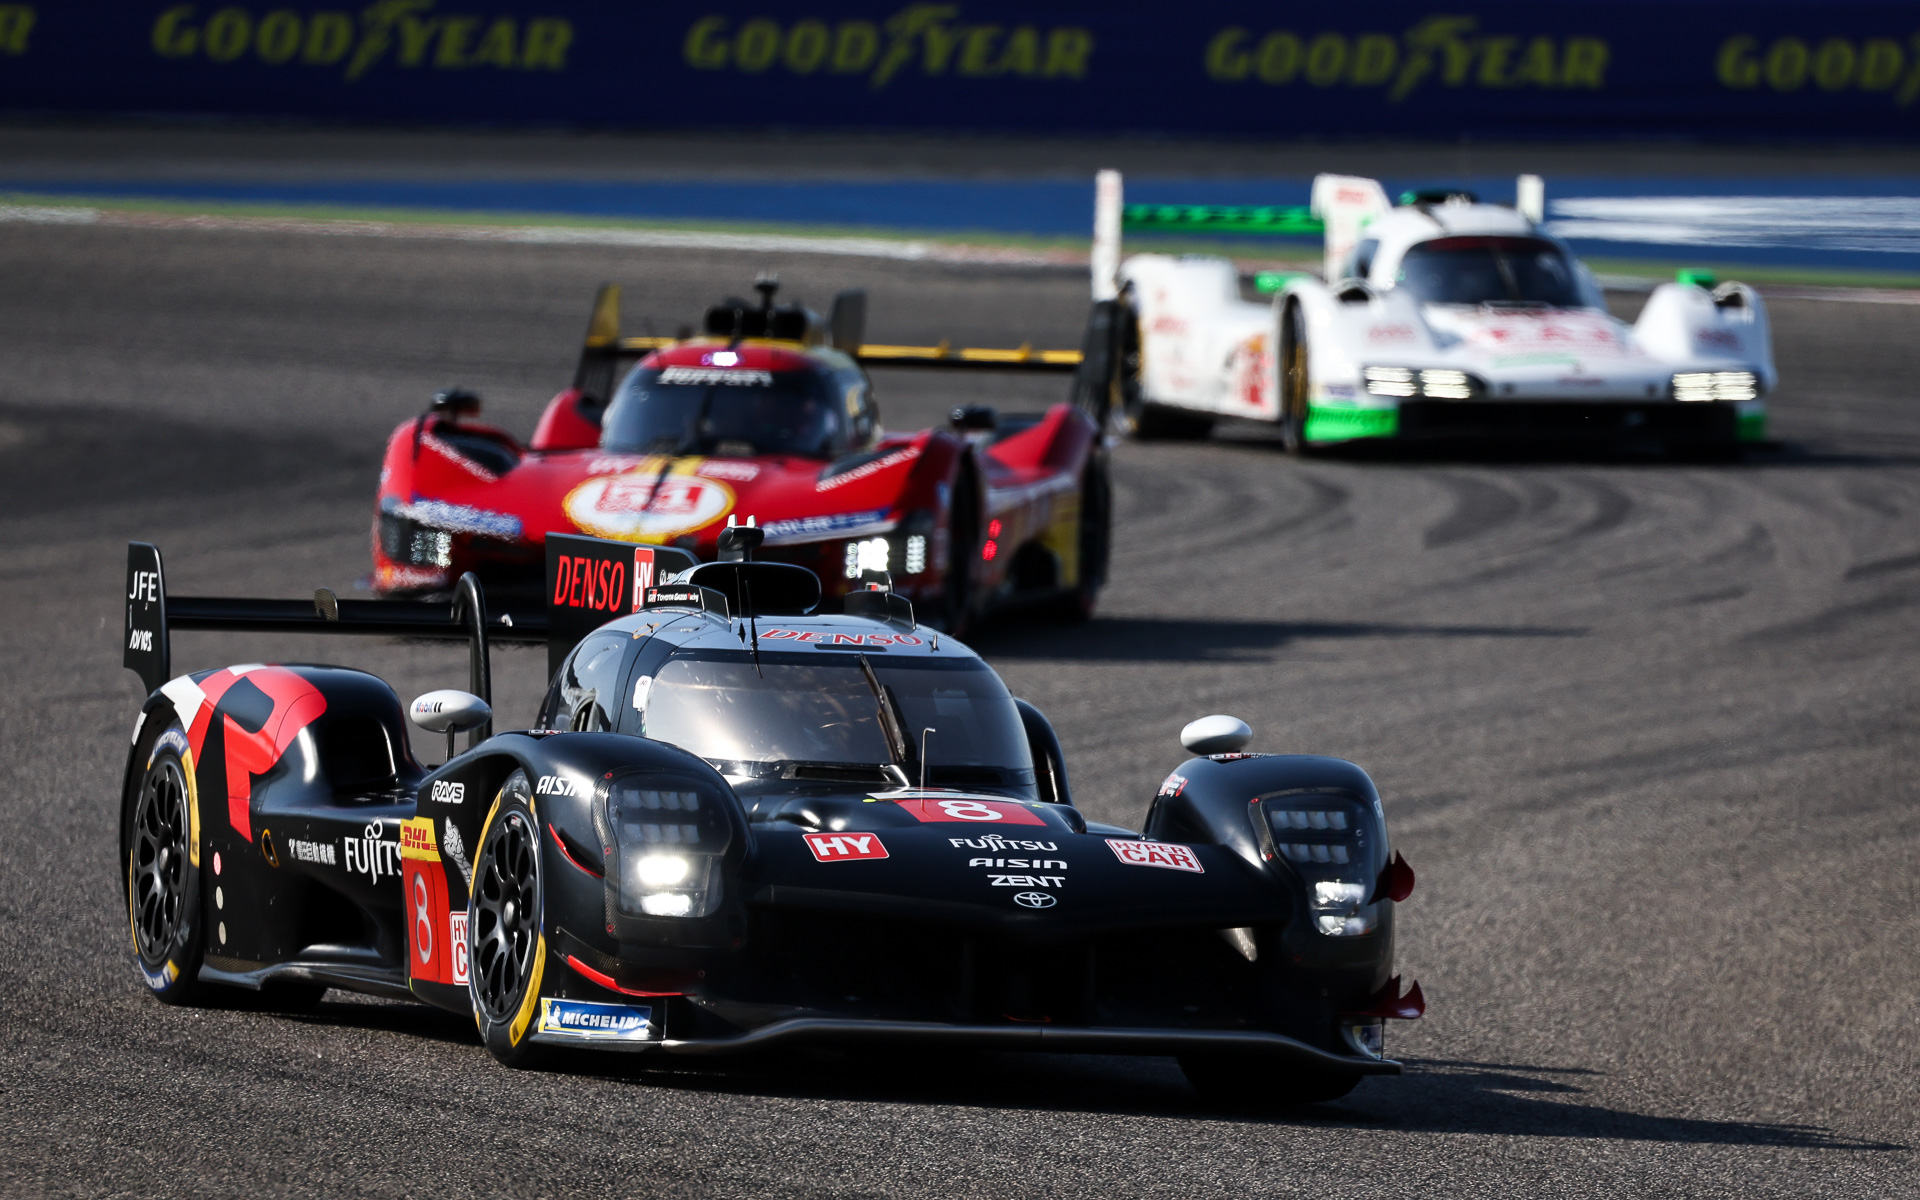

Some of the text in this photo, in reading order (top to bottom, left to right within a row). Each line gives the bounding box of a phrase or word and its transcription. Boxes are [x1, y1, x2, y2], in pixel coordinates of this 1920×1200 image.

[151, 2, 573, 72] GOODYEAR
[683, 10, 1094, 82] GOODYEAR
[1204, 20, 1610, 91] GOODYEAR
[1716, 33, 1920, 95] GOOD
[129, 570, 158, 602] JFE
[554, 555, 625, 612] DENSO
[758, 628, 923, 646] DENSO
[432, 781, 464, 803] RAYS
[937, 800, 1003, 821] 8
[404, 826, 430, 850] DHL
[812, 835, 873, 857] HY
[948, 834, 1058, 852] FUJITSU
[1114, 842, 1187, 856] HYPER
[344, 819, 402, 886] FUJITS
[969, 857, 1068, 869] AISIN
[1123, 849, 1196, 869] CAR
[987, 874, 1066, 888] ZENT
[414, 871, 432, 965] 8
[562, 1012, 640, 1029] MICHELIN
